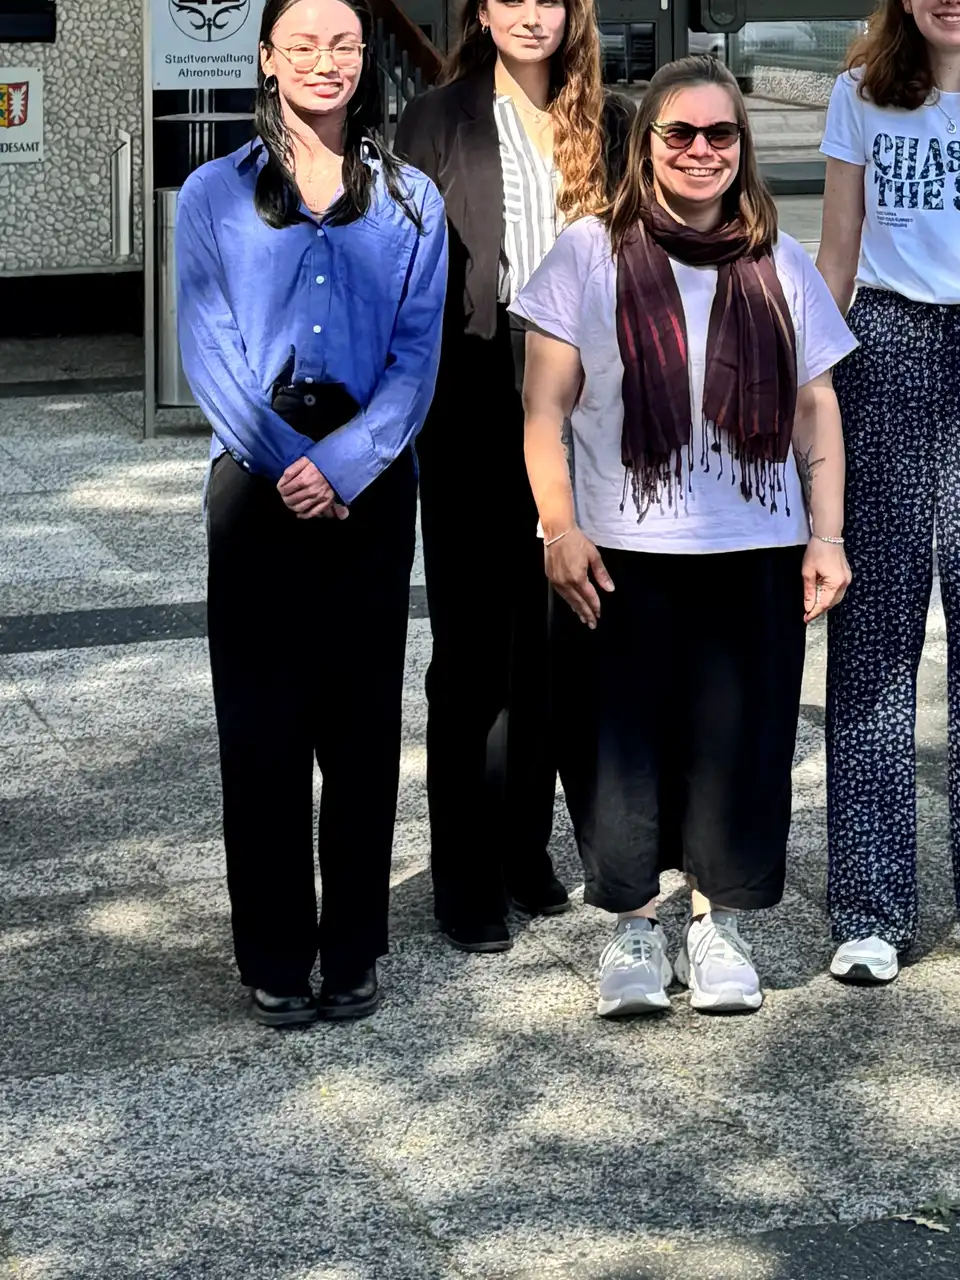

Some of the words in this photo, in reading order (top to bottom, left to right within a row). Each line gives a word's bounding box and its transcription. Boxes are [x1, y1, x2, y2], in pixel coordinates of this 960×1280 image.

[164, 53, 254, 64] Stadtverwaltung
[178, 68, 242, 78] Ahrensburg
[0, 142, 40, 152] DESAMT
[874, 170, 946, 211] THE
